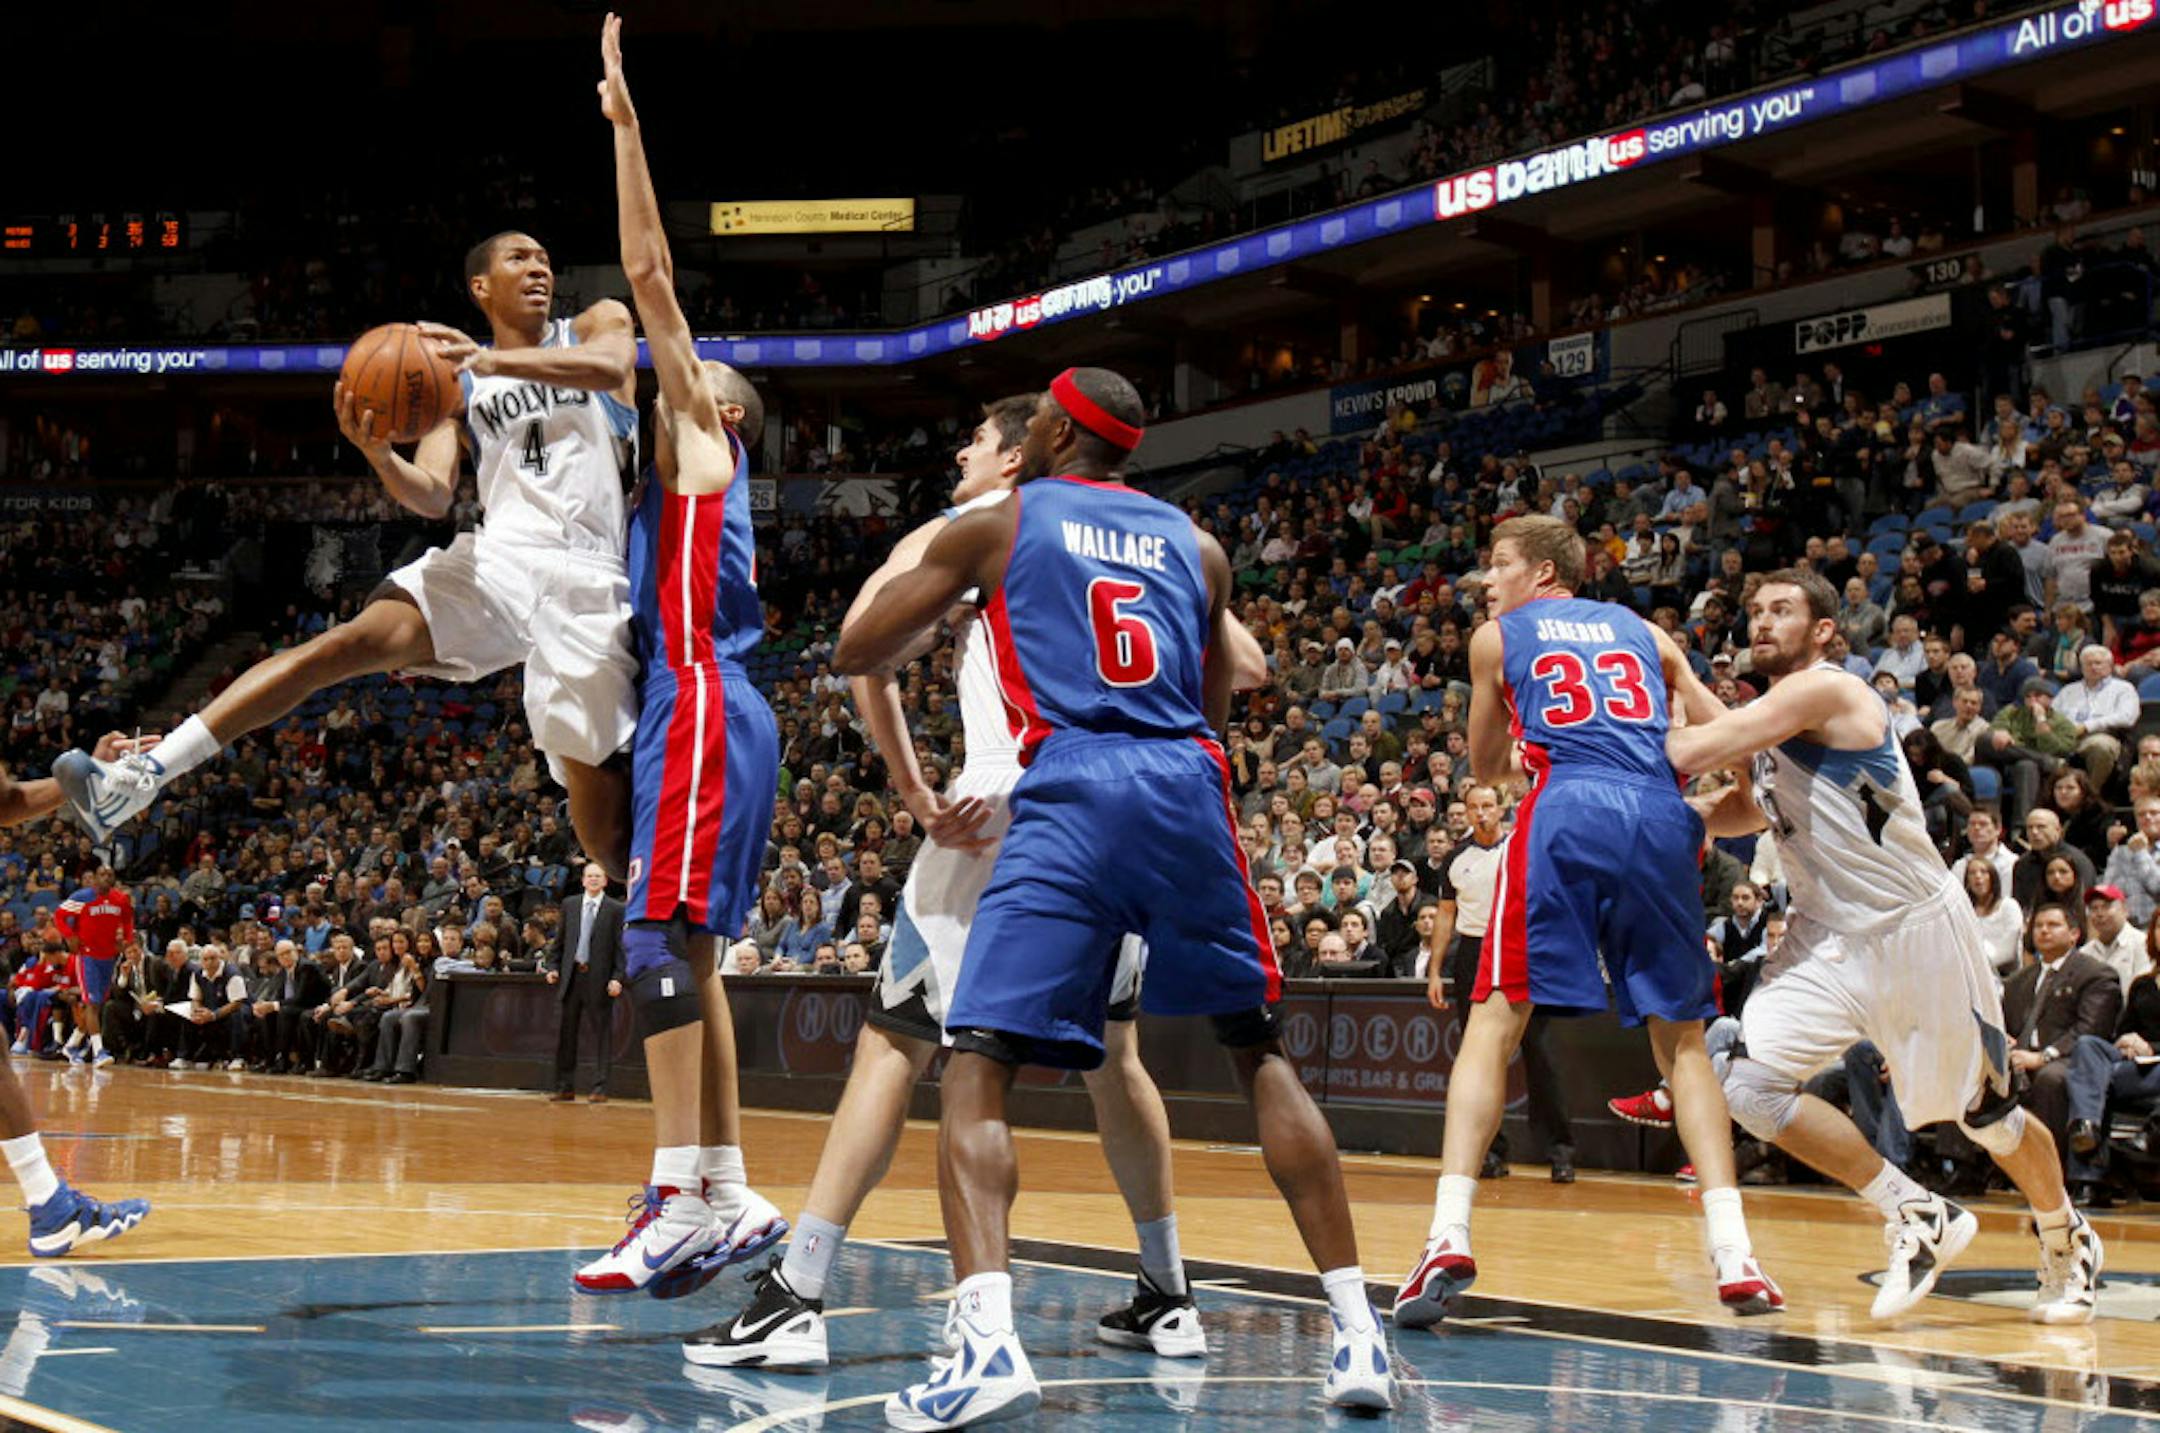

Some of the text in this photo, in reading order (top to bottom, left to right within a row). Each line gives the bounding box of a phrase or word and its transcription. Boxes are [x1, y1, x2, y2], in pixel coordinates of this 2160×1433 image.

[2013, 13, 2055, 54] All
[1649, 108, 1744, 154] serving
[830, 210, 869, 220] Medical
[1927, 260, 1960, 283] 130
[18, 349, 40, 369] of
[44, 353, 72, 369] us
[76, 348, 151, 373] serving
[1557, 351, 1586, 375] 129
[1335, 390, 1384, 417] KEVIN'S
[520, 418, 549, 476] 4
[1061, 520, 1167, 572] WALLACE
[1087, 576, 1160, 688] 6
[1532, 650, 1654, 728] 33
[1301, 1066, 1357, 1088] SPORTS
[1361, 1068, 1393, 1088] BAR
